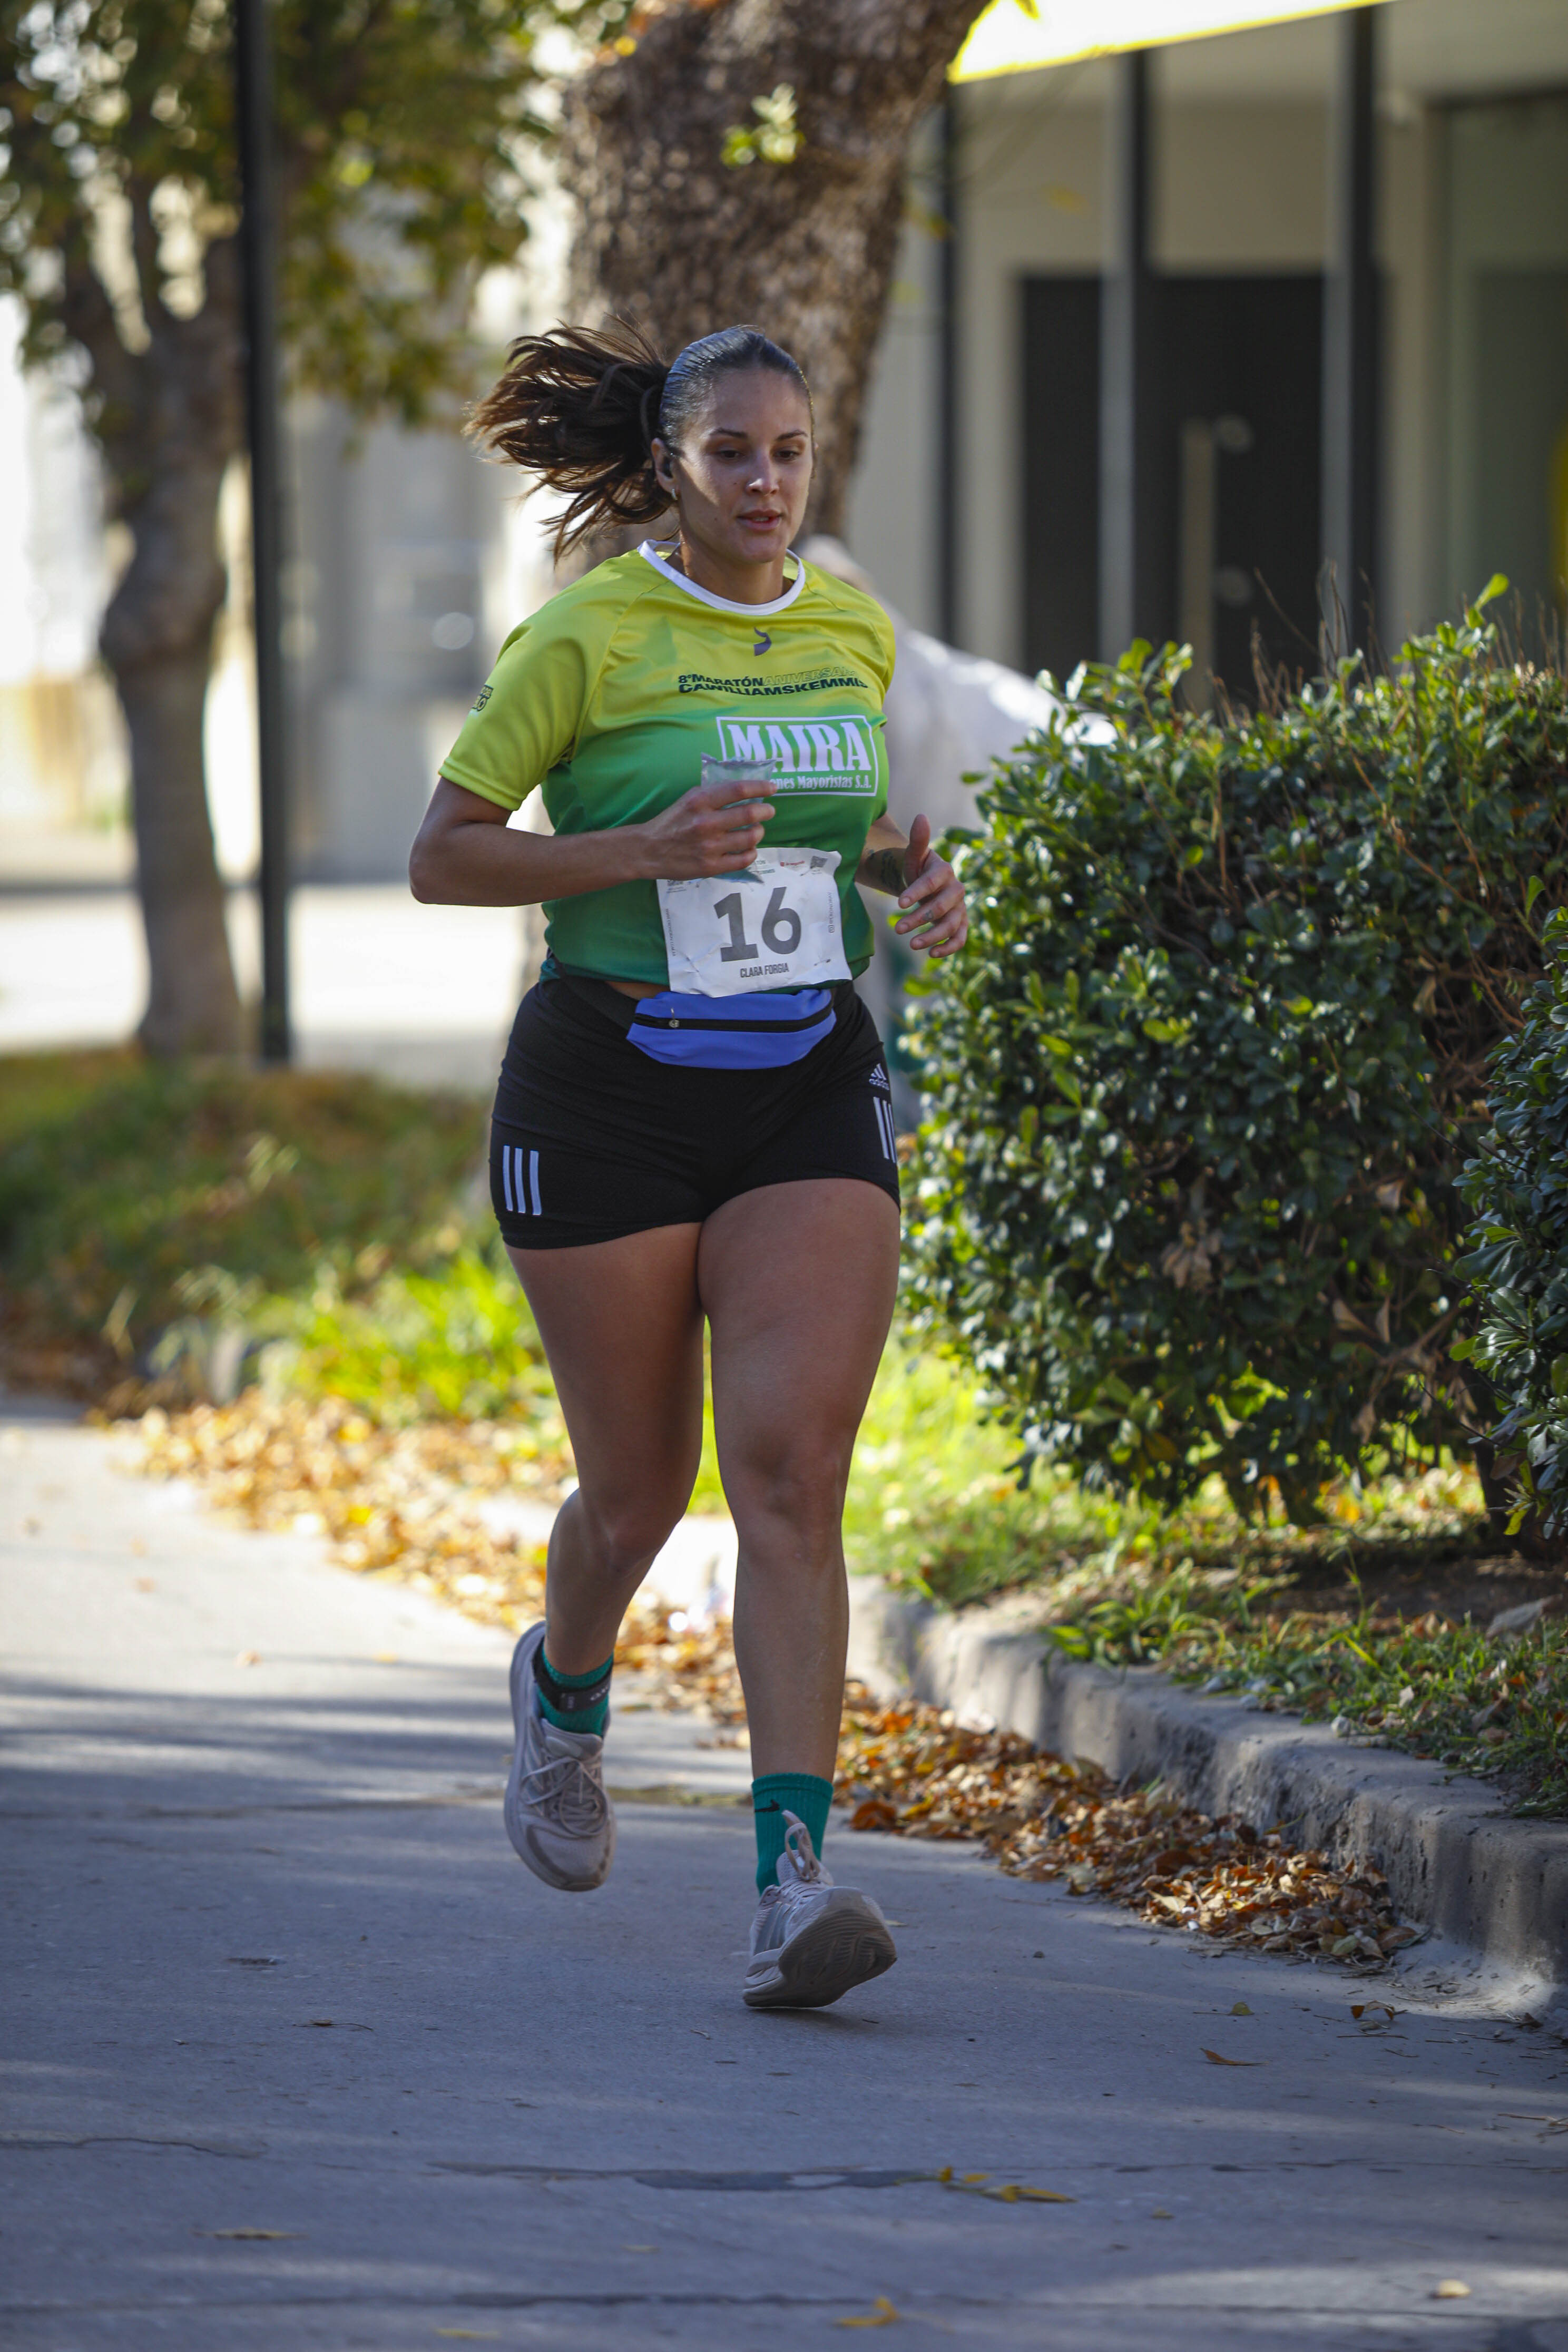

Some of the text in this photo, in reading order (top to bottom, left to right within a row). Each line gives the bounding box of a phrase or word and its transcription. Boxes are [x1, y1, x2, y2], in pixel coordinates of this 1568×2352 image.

[727, 722, 871, 772] MAIRA
[797, 775, 852, 789] Mayoristas
[855, 775, 871, 788] S.A.
[713, 886, 801, 962] 16
[740, 963, 789, 977] CLARA FORGIA
[869, 1079, 889, 1091] adidas
